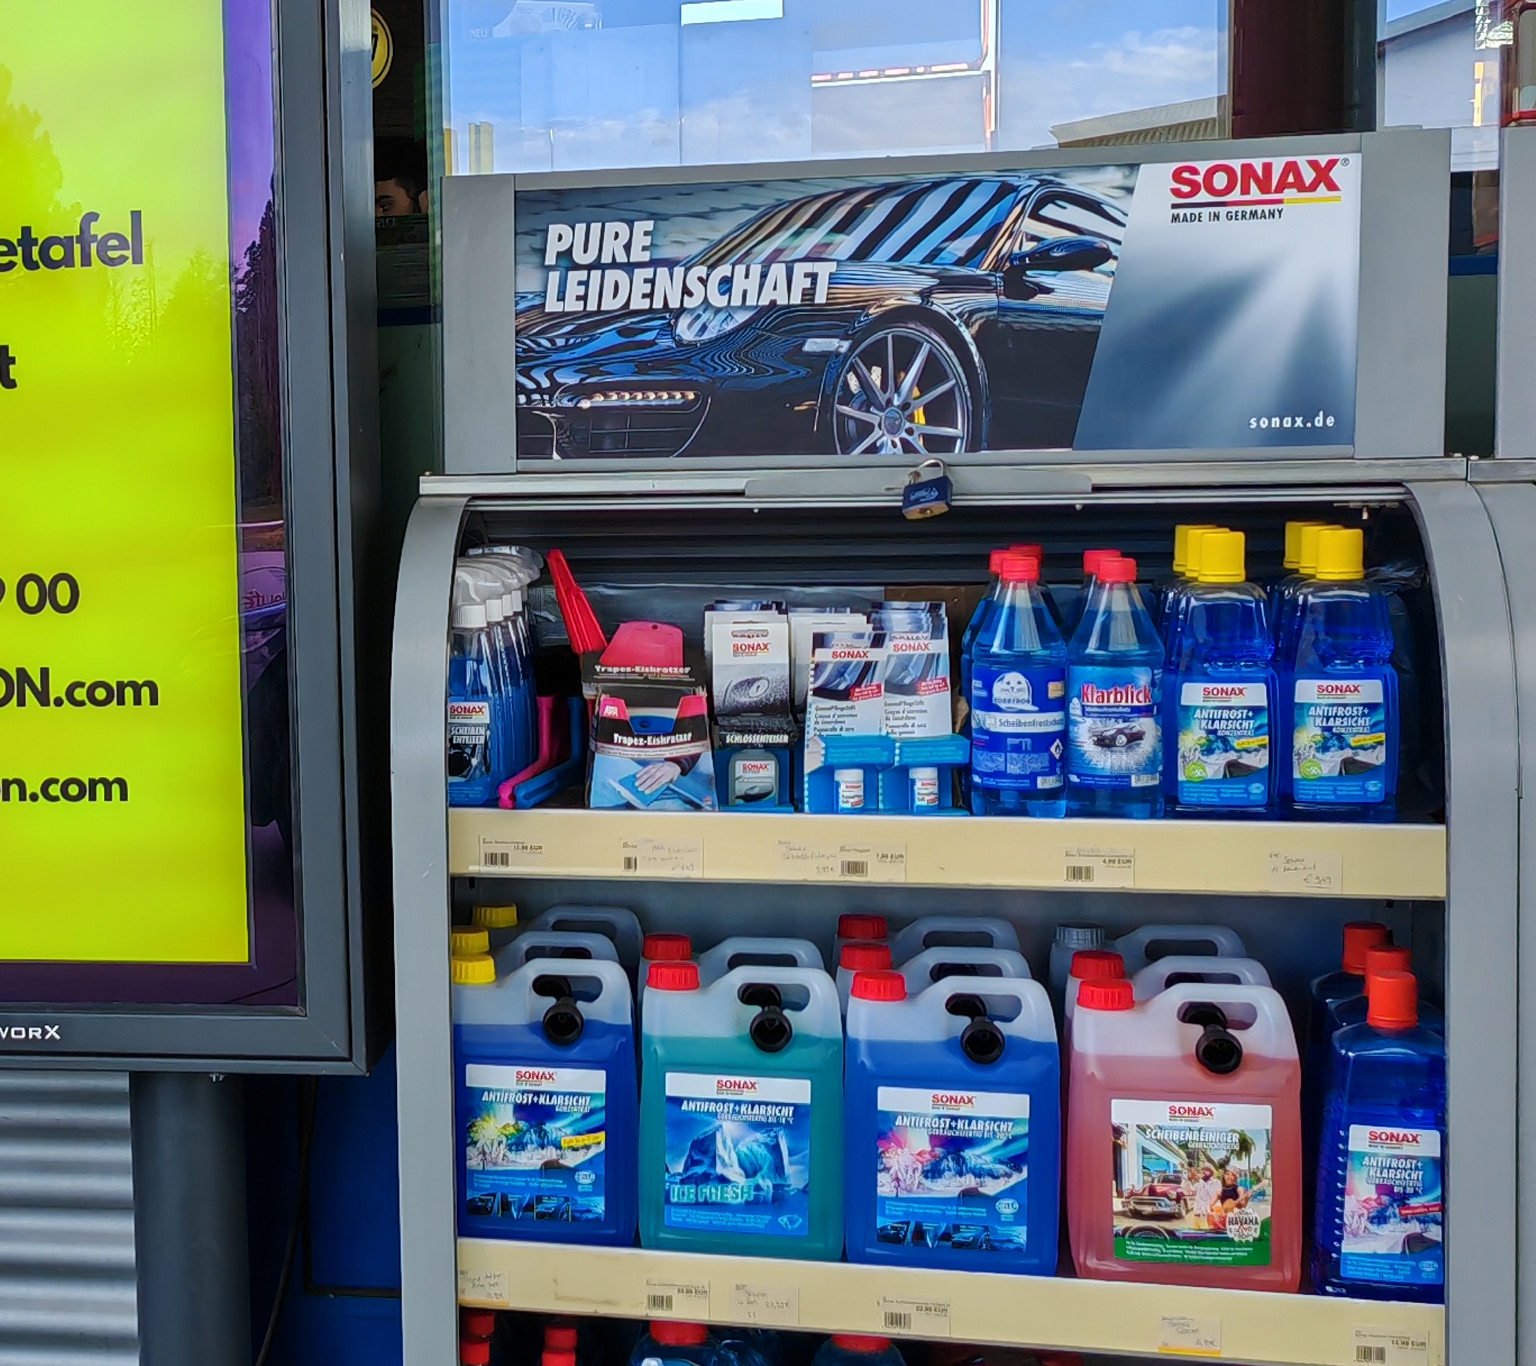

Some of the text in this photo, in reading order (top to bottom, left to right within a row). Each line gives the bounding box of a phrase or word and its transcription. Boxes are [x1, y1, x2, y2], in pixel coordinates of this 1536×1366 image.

[1170, 208, 1285, 224] MADE IN GERMANY
[544, 219, 655, 266] PURE
[543, 260, 838, 314] LEIDENSCHAFT
[1248, 410, 1336, 430] sonax.de
[15, 572, 81, 616] 00
[1081, 682, 1153, 706] Klarblick
[1202, 686, 1247, 698] SONAX
[1316, 683, 1361, 695] SONAX
[1199, 719, 1255, 731] KLARSICHT
[1315, 716, 1371, 728] KLARSICHT
[515, 1070, 556, 1081] SONAX
[715, 1078, 758, 1091] SONAX
[931, 1093, 974, 1106] SONAX
[1168, 1104, 1214, 1117] SONAX
[1368, 1129, 1421, 1144] SONAX
[670, 1184, 697, 1203] ICE
